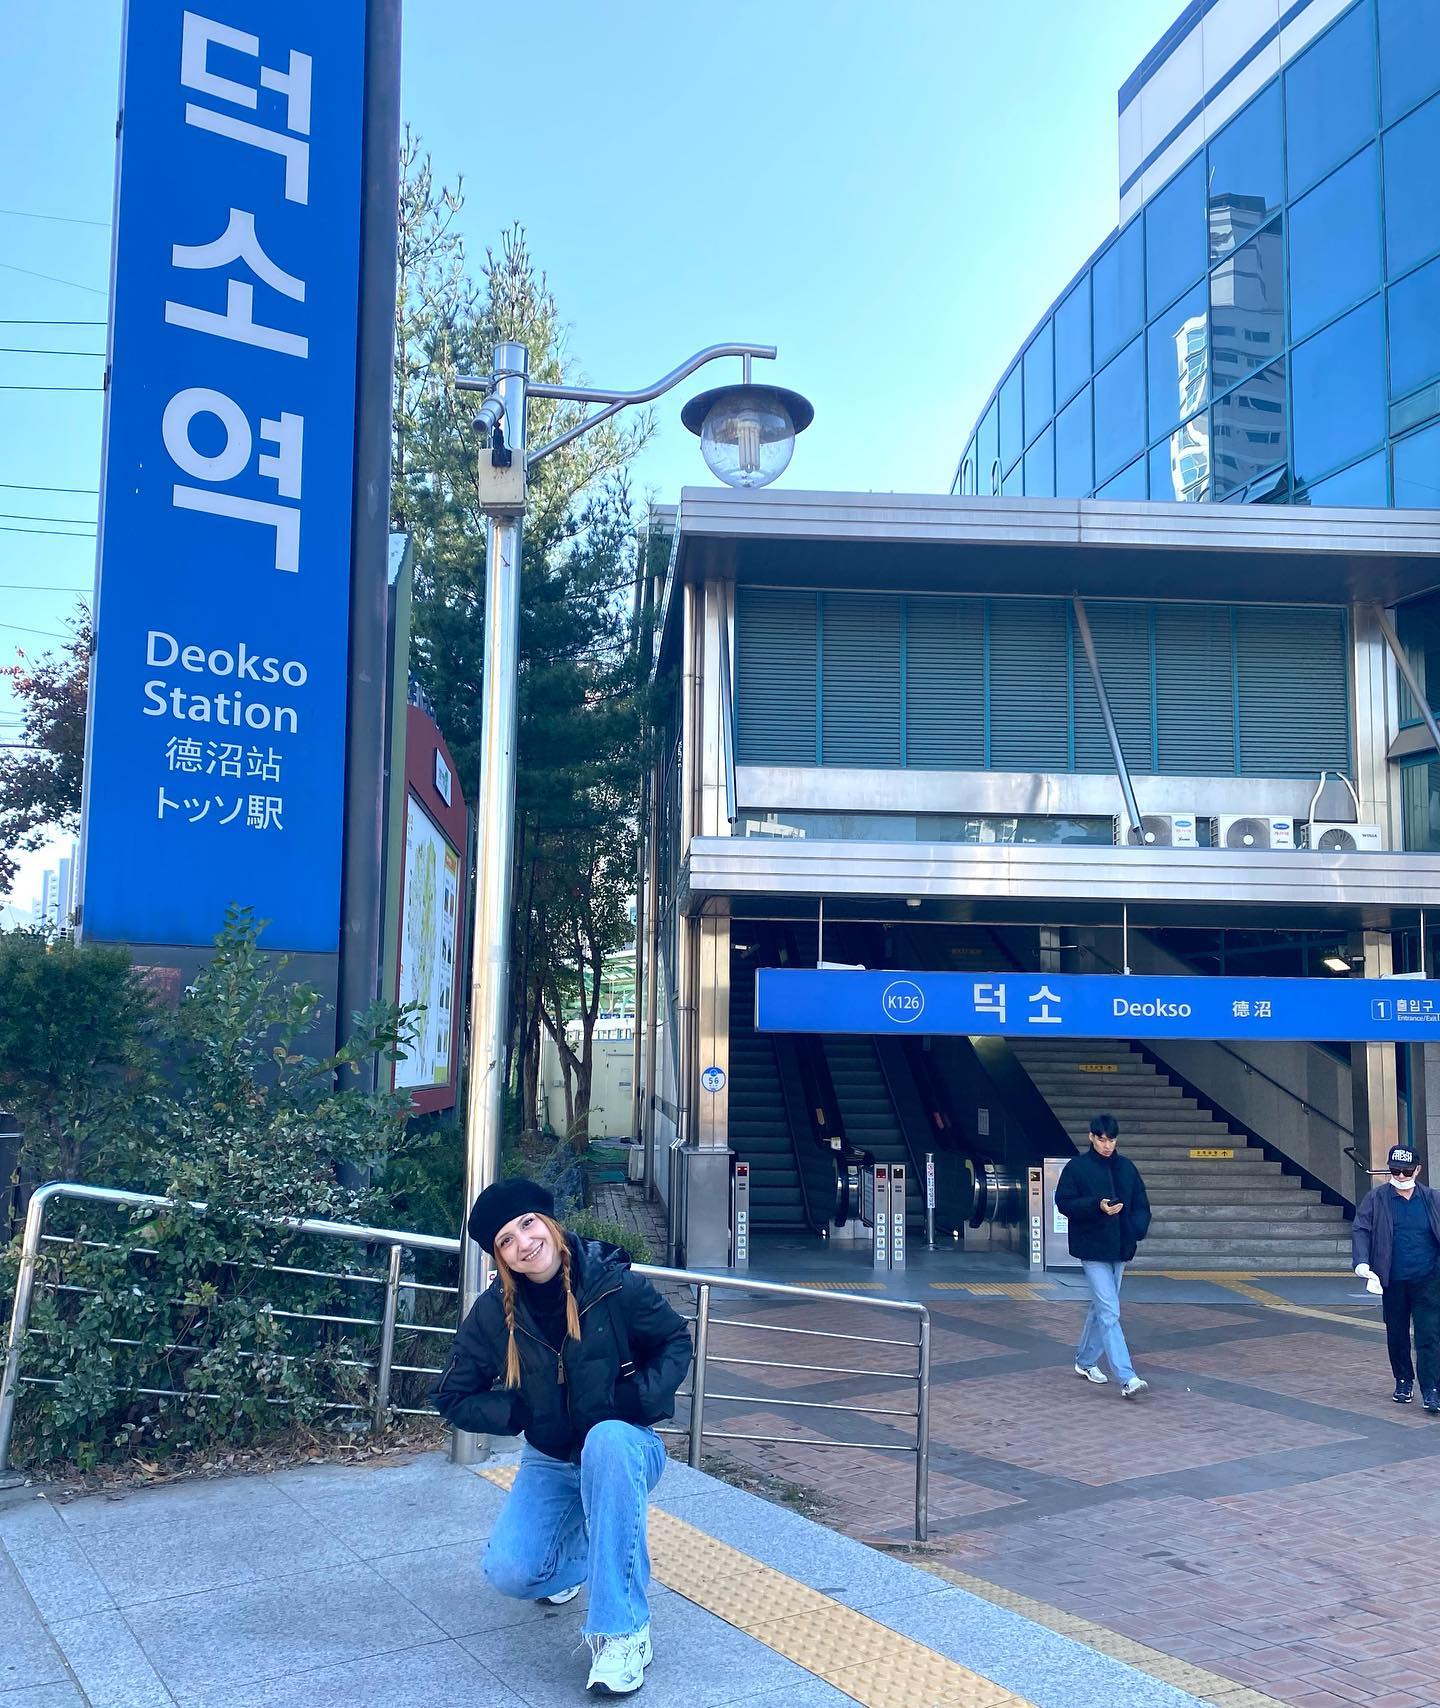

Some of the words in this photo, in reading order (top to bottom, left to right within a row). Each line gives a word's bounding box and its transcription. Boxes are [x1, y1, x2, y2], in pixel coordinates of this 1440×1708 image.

[162, 10, 313, 574] 덕소역
[146, 630, 308, 686] Deokso
[142, 680, 299, 734] Station
[164, 736, 283, 783] 德沼站
[157, 786, 284, 831] トッソ駅
[887, 995, 920, 1010] K126
[1112, 998, 1192, 1018] Deokso
[1231, 1000, 1273, 1018] 德沼
[1377, 1001, 1385, 1018] 1
